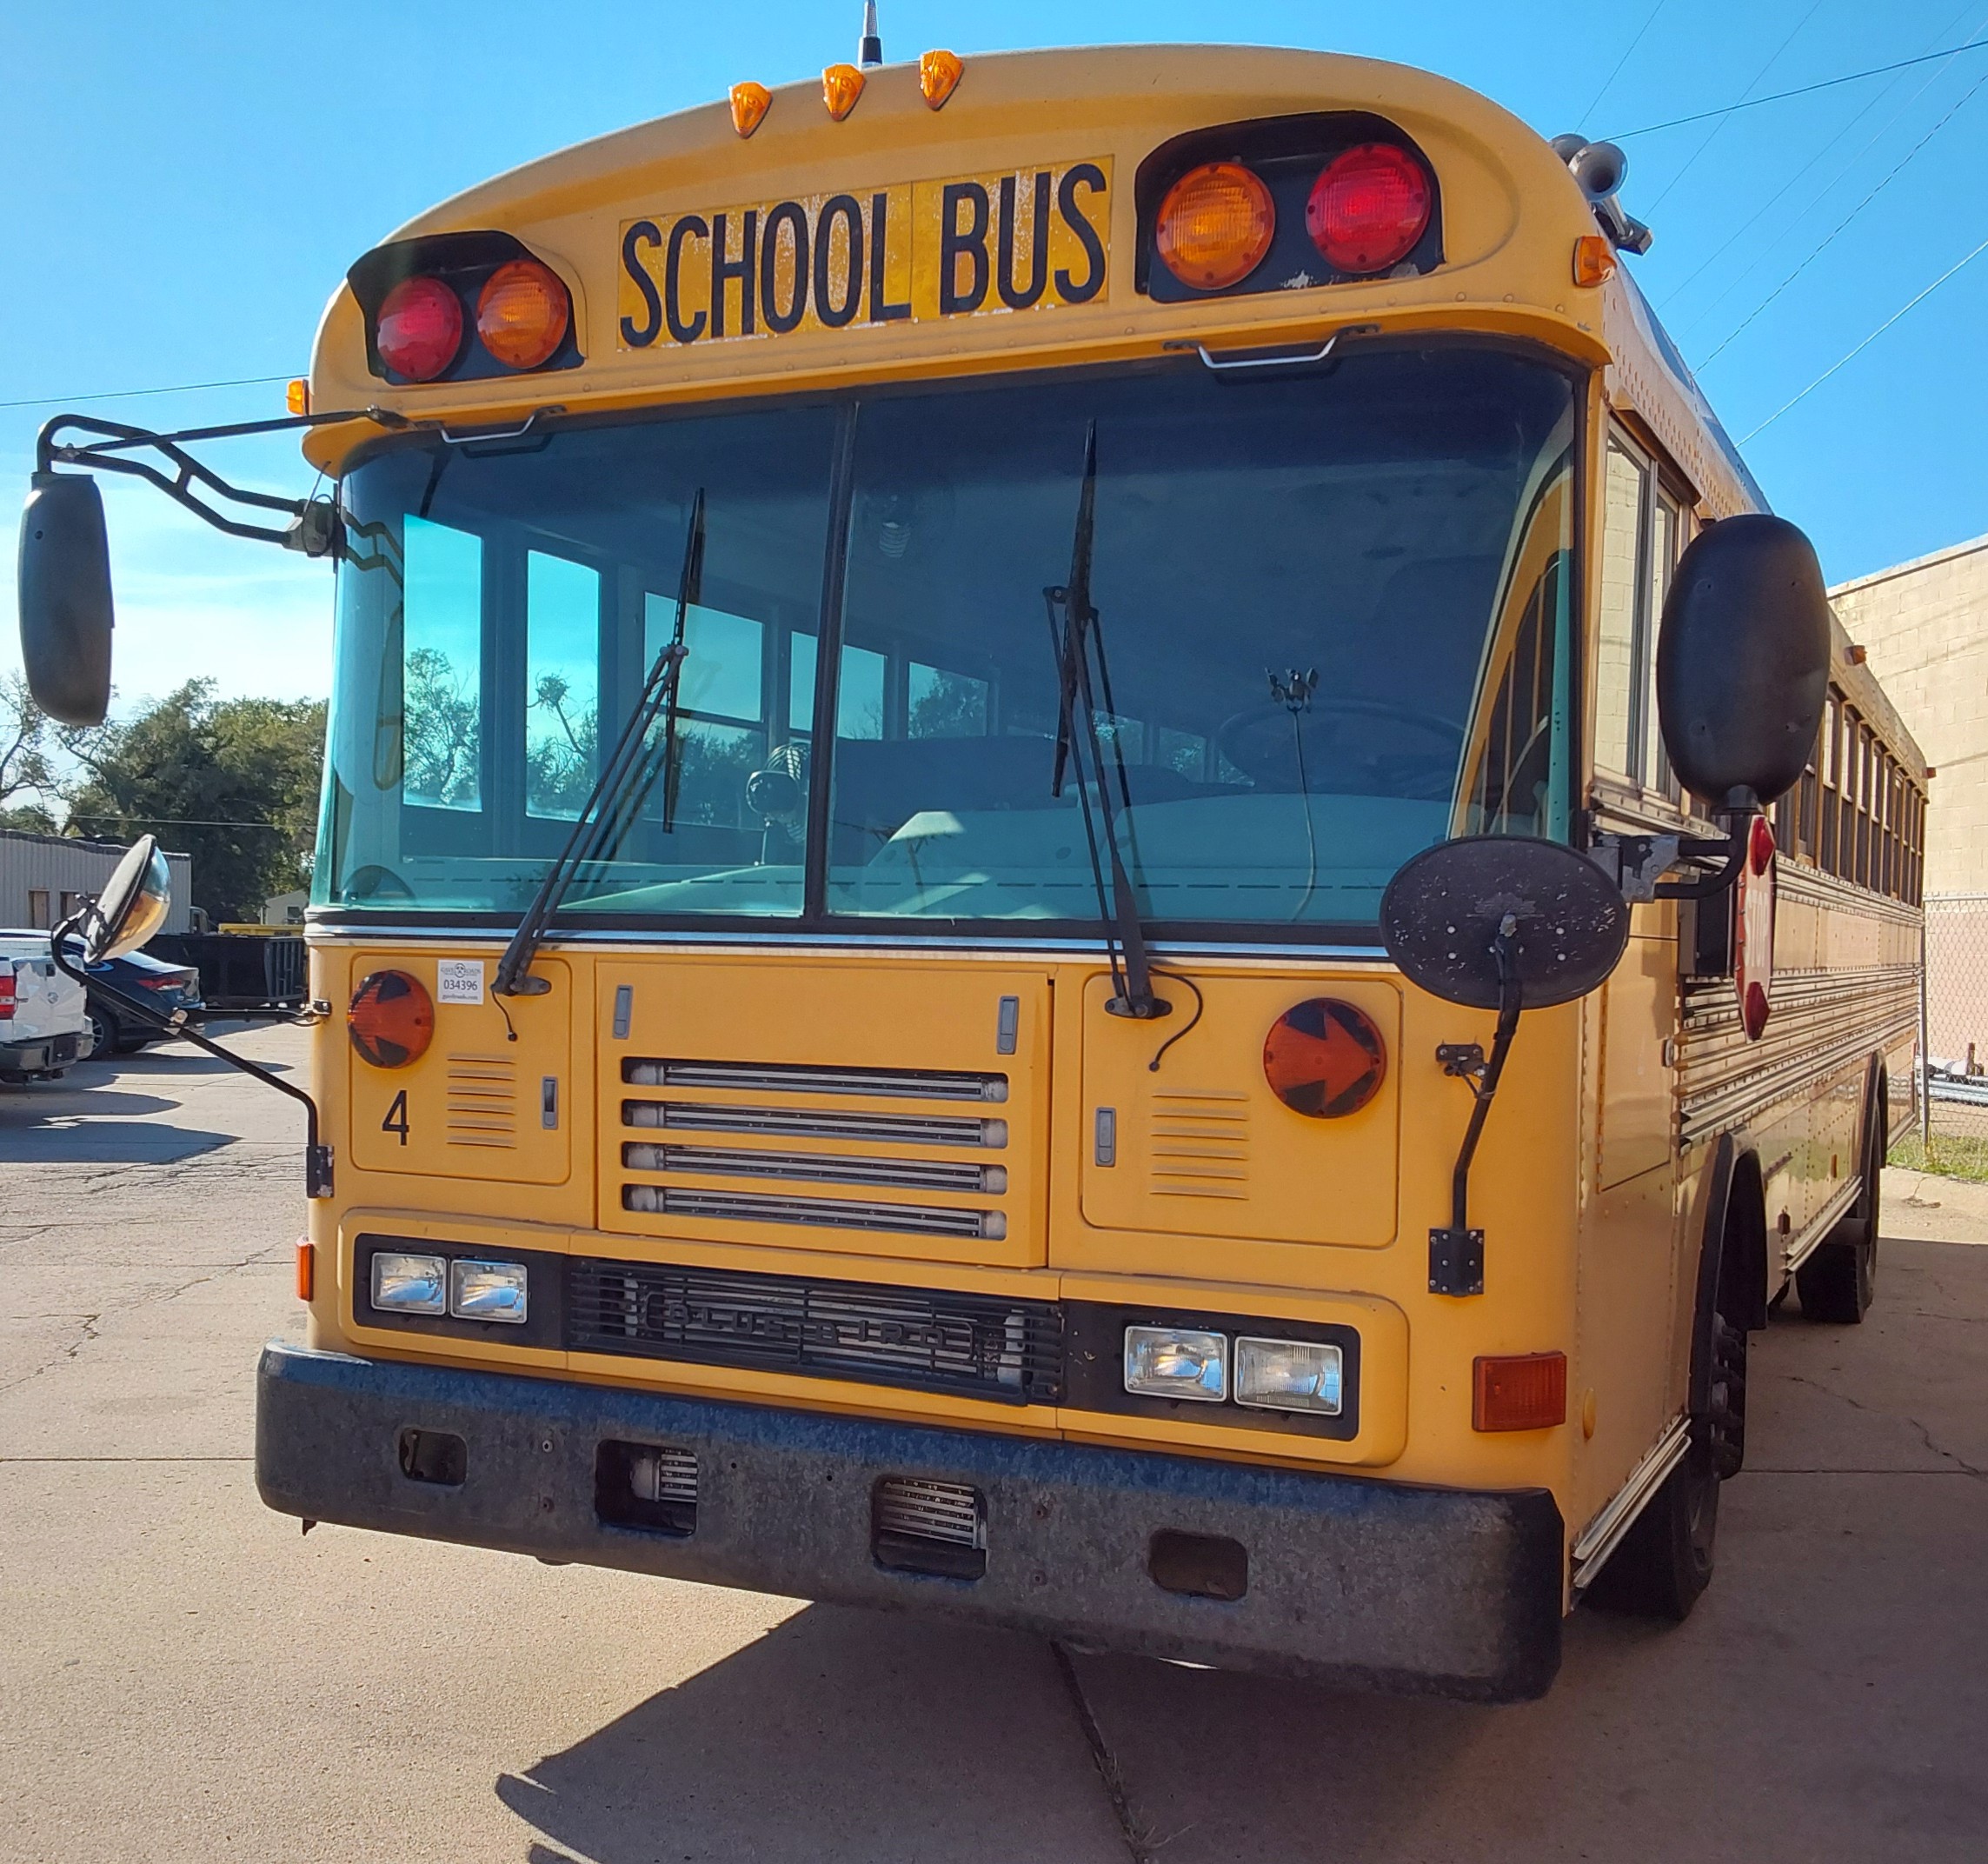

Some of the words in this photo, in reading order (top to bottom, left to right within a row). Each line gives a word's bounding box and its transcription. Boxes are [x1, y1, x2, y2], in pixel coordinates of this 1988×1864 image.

[620, 193, 912, 348] SCHOOL
[940, 163, 1107, 316] BUS
[1743, 888, 1769, 968] STOP
[443, 979, 478, 991] 034396
[382, 1089, 410, 1146] 4
[668, 1303, 785, 1338] BLUE
[814, 1319, 947, 1349] BIRD
